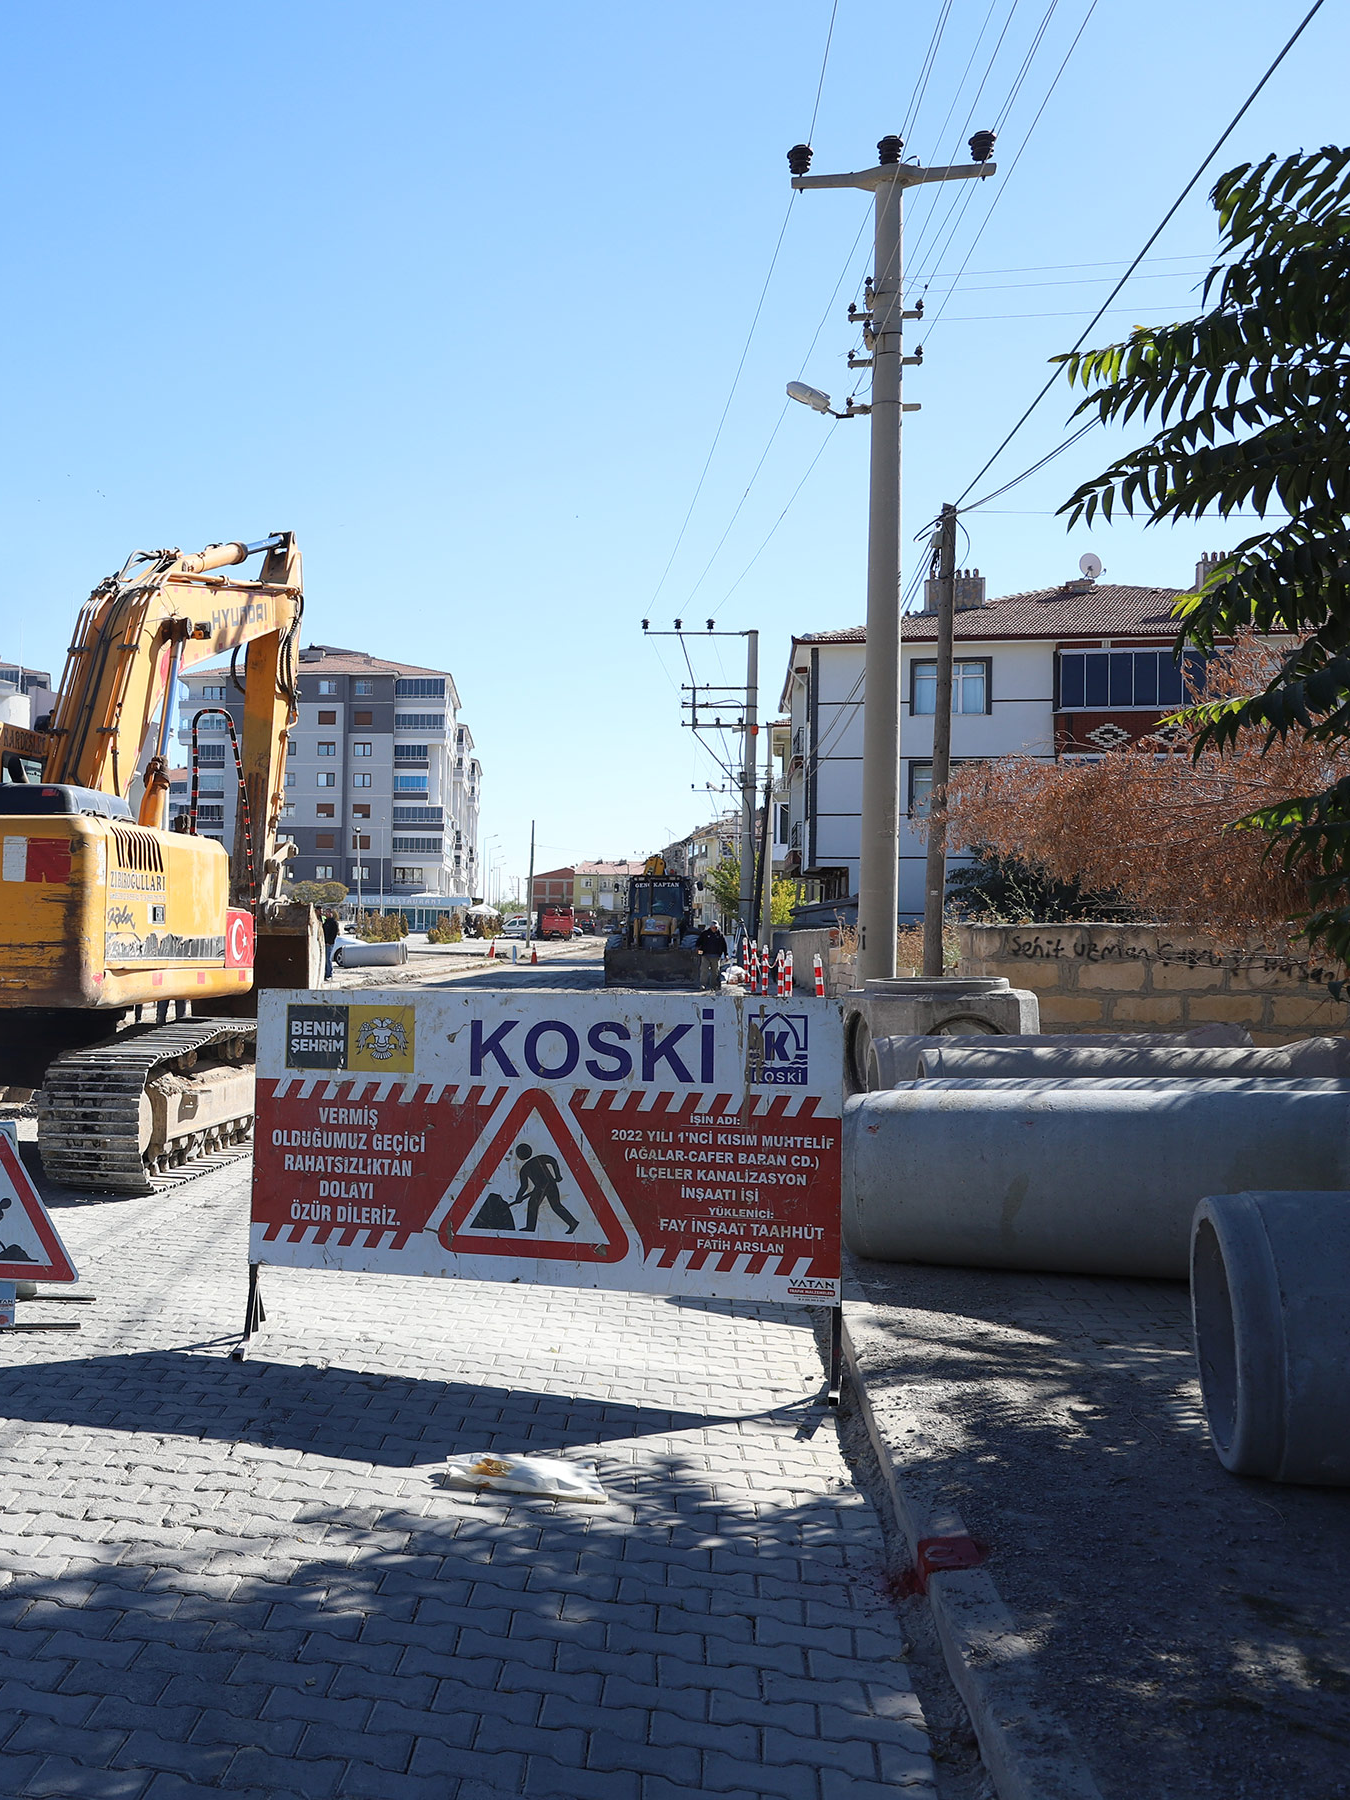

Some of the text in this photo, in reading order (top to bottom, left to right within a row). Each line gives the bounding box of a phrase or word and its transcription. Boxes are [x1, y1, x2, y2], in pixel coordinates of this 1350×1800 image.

[212, 603, 267, 630] HYUNDAI
[470, 1008, 714, 1084] KOSKİ
[319, 1105, 379, 1131] VERMİŞ
[690, 1113, 741, 1126] İŞİN ADI:
[272, 1127, 426, 1156] OLDUĞUMUZ GEÇİCİ
[611, 1129, 835, 1149] 2022 YILI 1'NCİ KISIM MUHTELİF
[284, 1153, 412, 1177] RAHATSIZLIKTAN
[624, 1146, 820, 1170] (AĞALAR-CAFER BARAN CD.)
[636, 1165, 807, 1186] İLÇELER KANALİZASYON
[319, 1180, 374, 1199] DOLAYI
[681, 1184, 759, 1203] İNŞAATI İŞİ
[290, 1199, 400, 1226] ÖZÜR DİLERİZ.
[708, 1206, 774, 1219] YÜKLENİCİ:
[659, 1218, 825, 1240] FAY İNŞAAT TAAHHÜT
[697, 1237, 785, 1253] FATİH ARSLAN
[789, 1278, 835, 1289] VATAN
